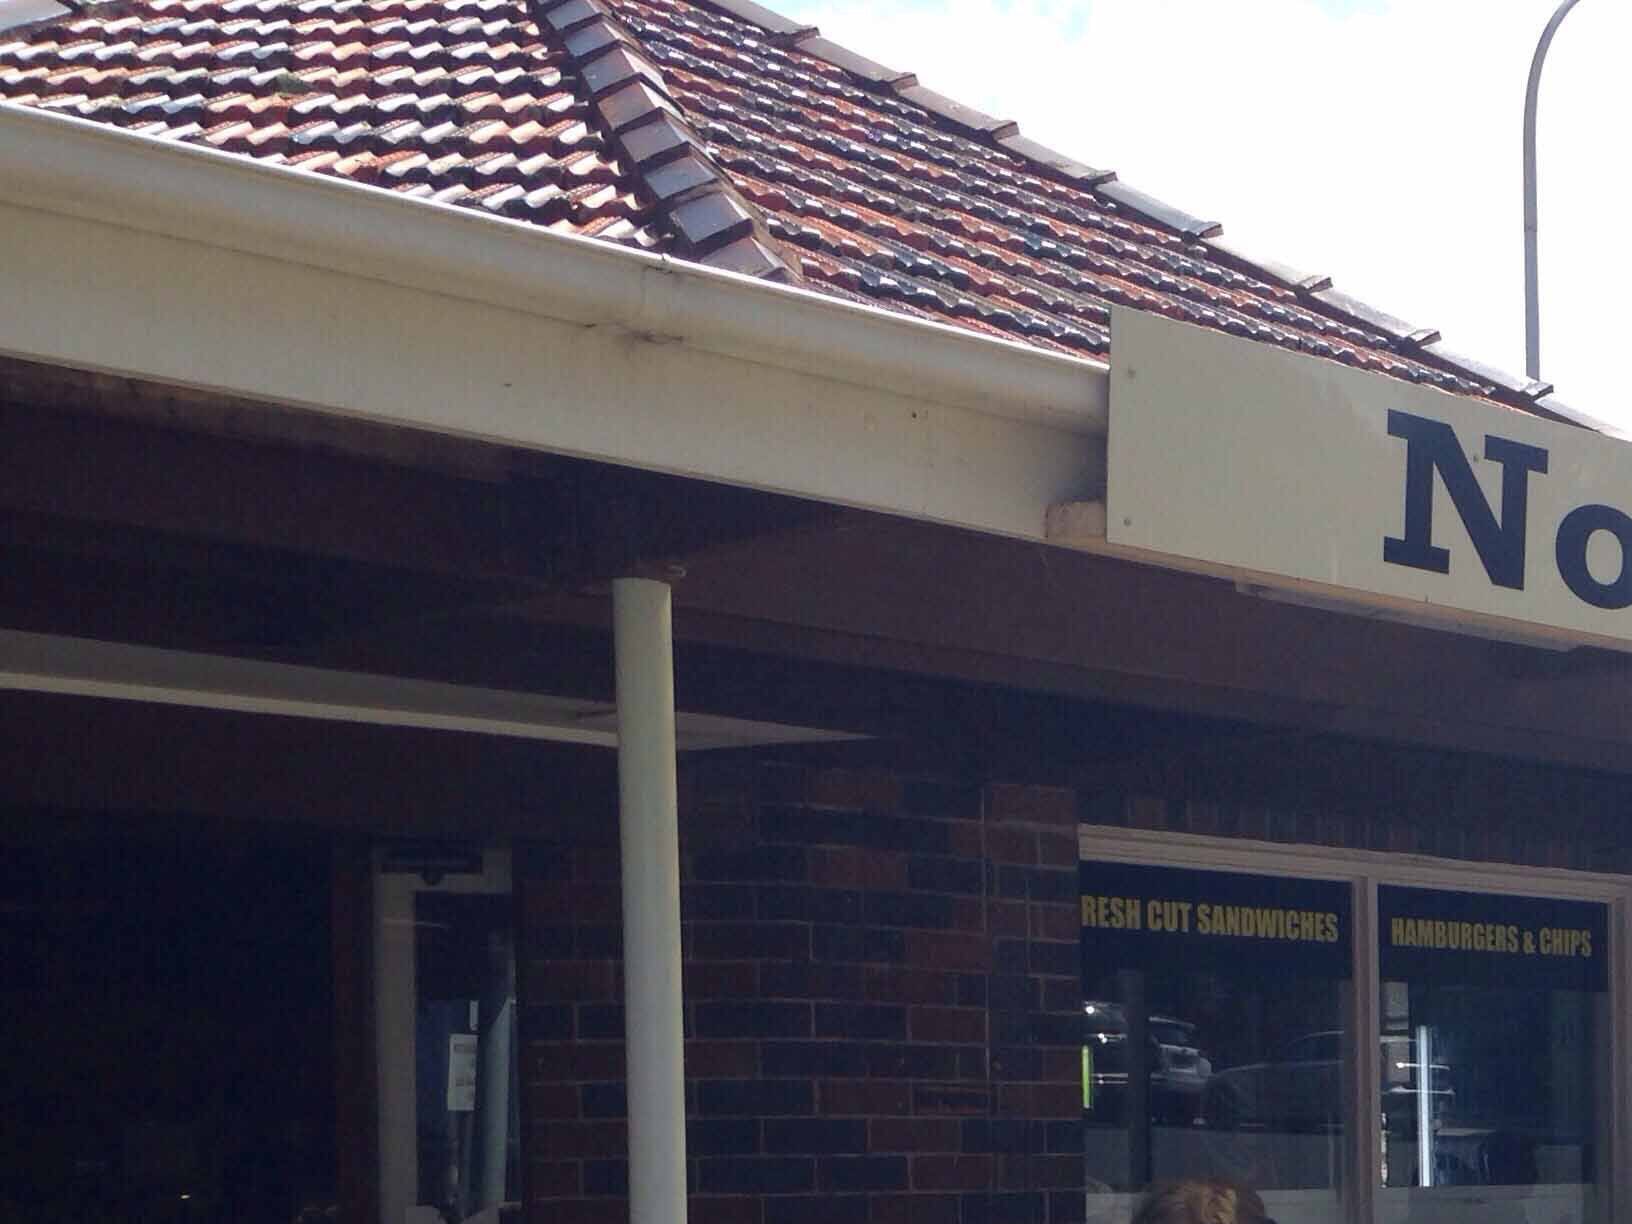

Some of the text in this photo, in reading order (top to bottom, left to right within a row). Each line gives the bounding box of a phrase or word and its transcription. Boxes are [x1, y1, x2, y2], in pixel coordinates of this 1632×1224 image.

[1081, 895, 1339, 943] RESH CUT SANDWICHES
[1391, 917, 1592, 957] HAMBURGERS & CHIPS
